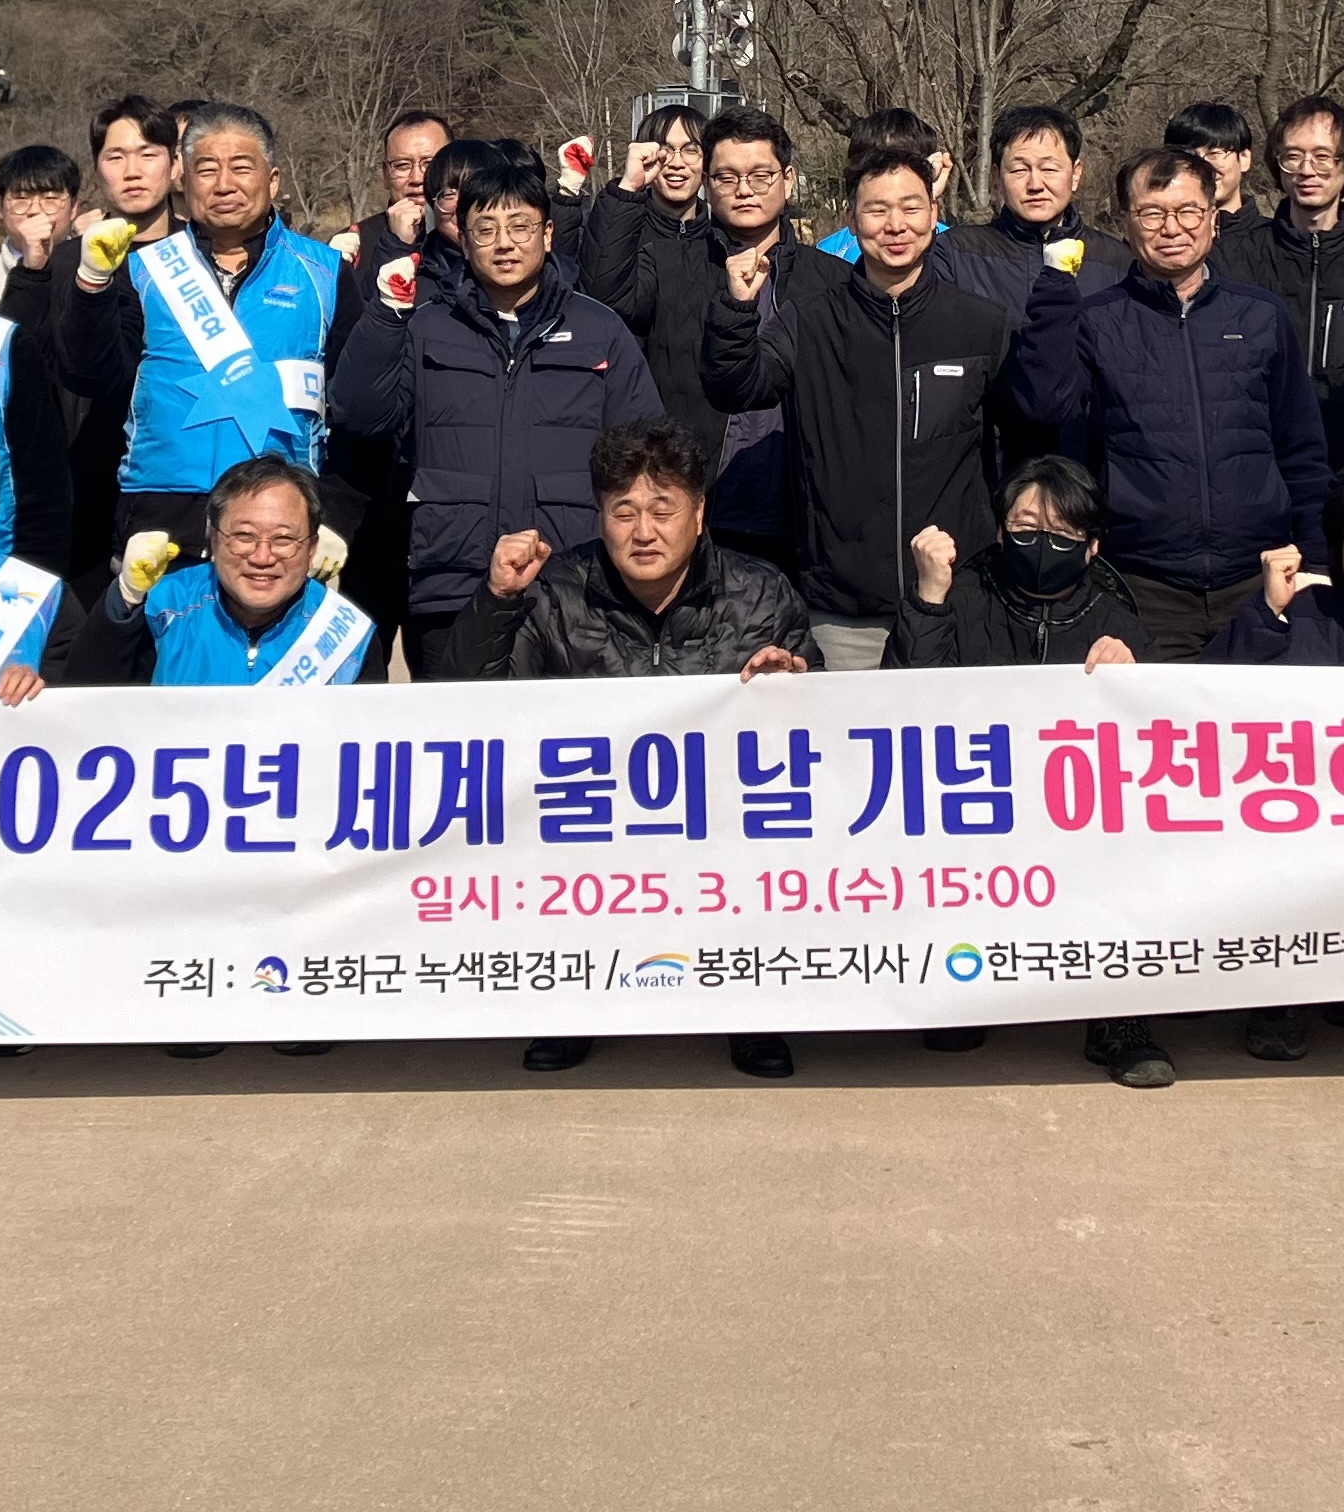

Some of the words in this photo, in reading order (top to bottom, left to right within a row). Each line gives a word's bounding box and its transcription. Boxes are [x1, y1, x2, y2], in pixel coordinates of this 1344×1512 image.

[177, 279, 227, 341] 드세요
[314, 604, 357, 661] 수돗물
[325, 739, 505, 851] 세계
[534, 731, 708, 844] 물의
[737, 728, 822, 839] 날
[848, 724, 1015, 836] 기념
[410, 874, 500, 923] 일시
[920, 864, 1057, 909] 15:00
[144, 956, 214, 998] 주최
[298, 954, 407, 996] 봉화군
[415, 949, 596, 994] 녹색환경과
[635, 972, 685, 988] water
[692, 943, 910, 987] 봉화수도지사
[985, 938, 1205, 982] 한국환경공단
